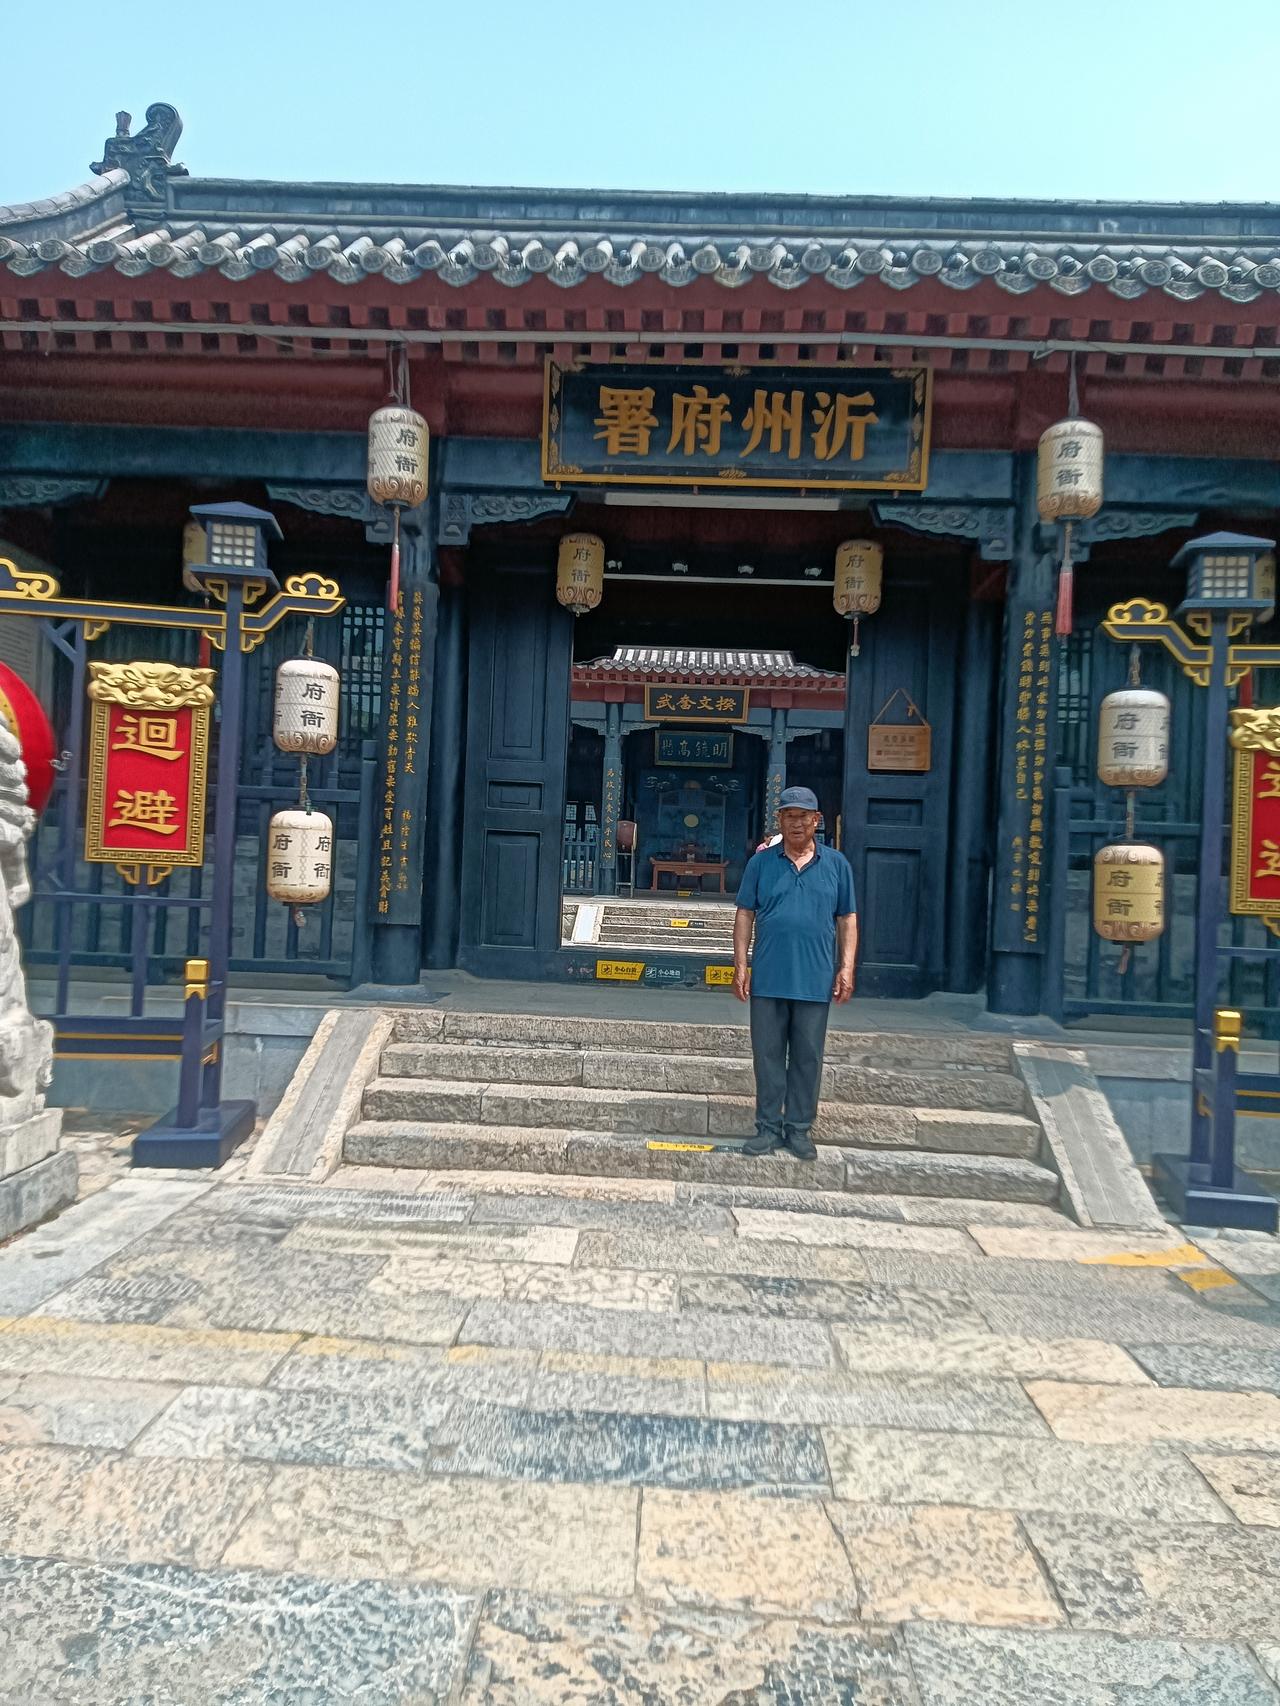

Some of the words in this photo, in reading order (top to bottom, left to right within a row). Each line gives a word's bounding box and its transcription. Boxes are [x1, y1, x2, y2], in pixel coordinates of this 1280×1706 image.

[395, 428, 418, 475] 府衙
[1056, 440, 1083, 487] 府衙
[572, 547, 591, 583] 府衙
[844, 554, 864, 589] 府衙
[300, 683, 326, 728] 府衙
[1112, 711, 1139, 759] 府衙
[108, 714, 185, 835] 迴避
[272, 834, 293, 878] 府衙
[313, 836, 331, 879] 府衙
[1106, 870, 1134, 916] 府衙
